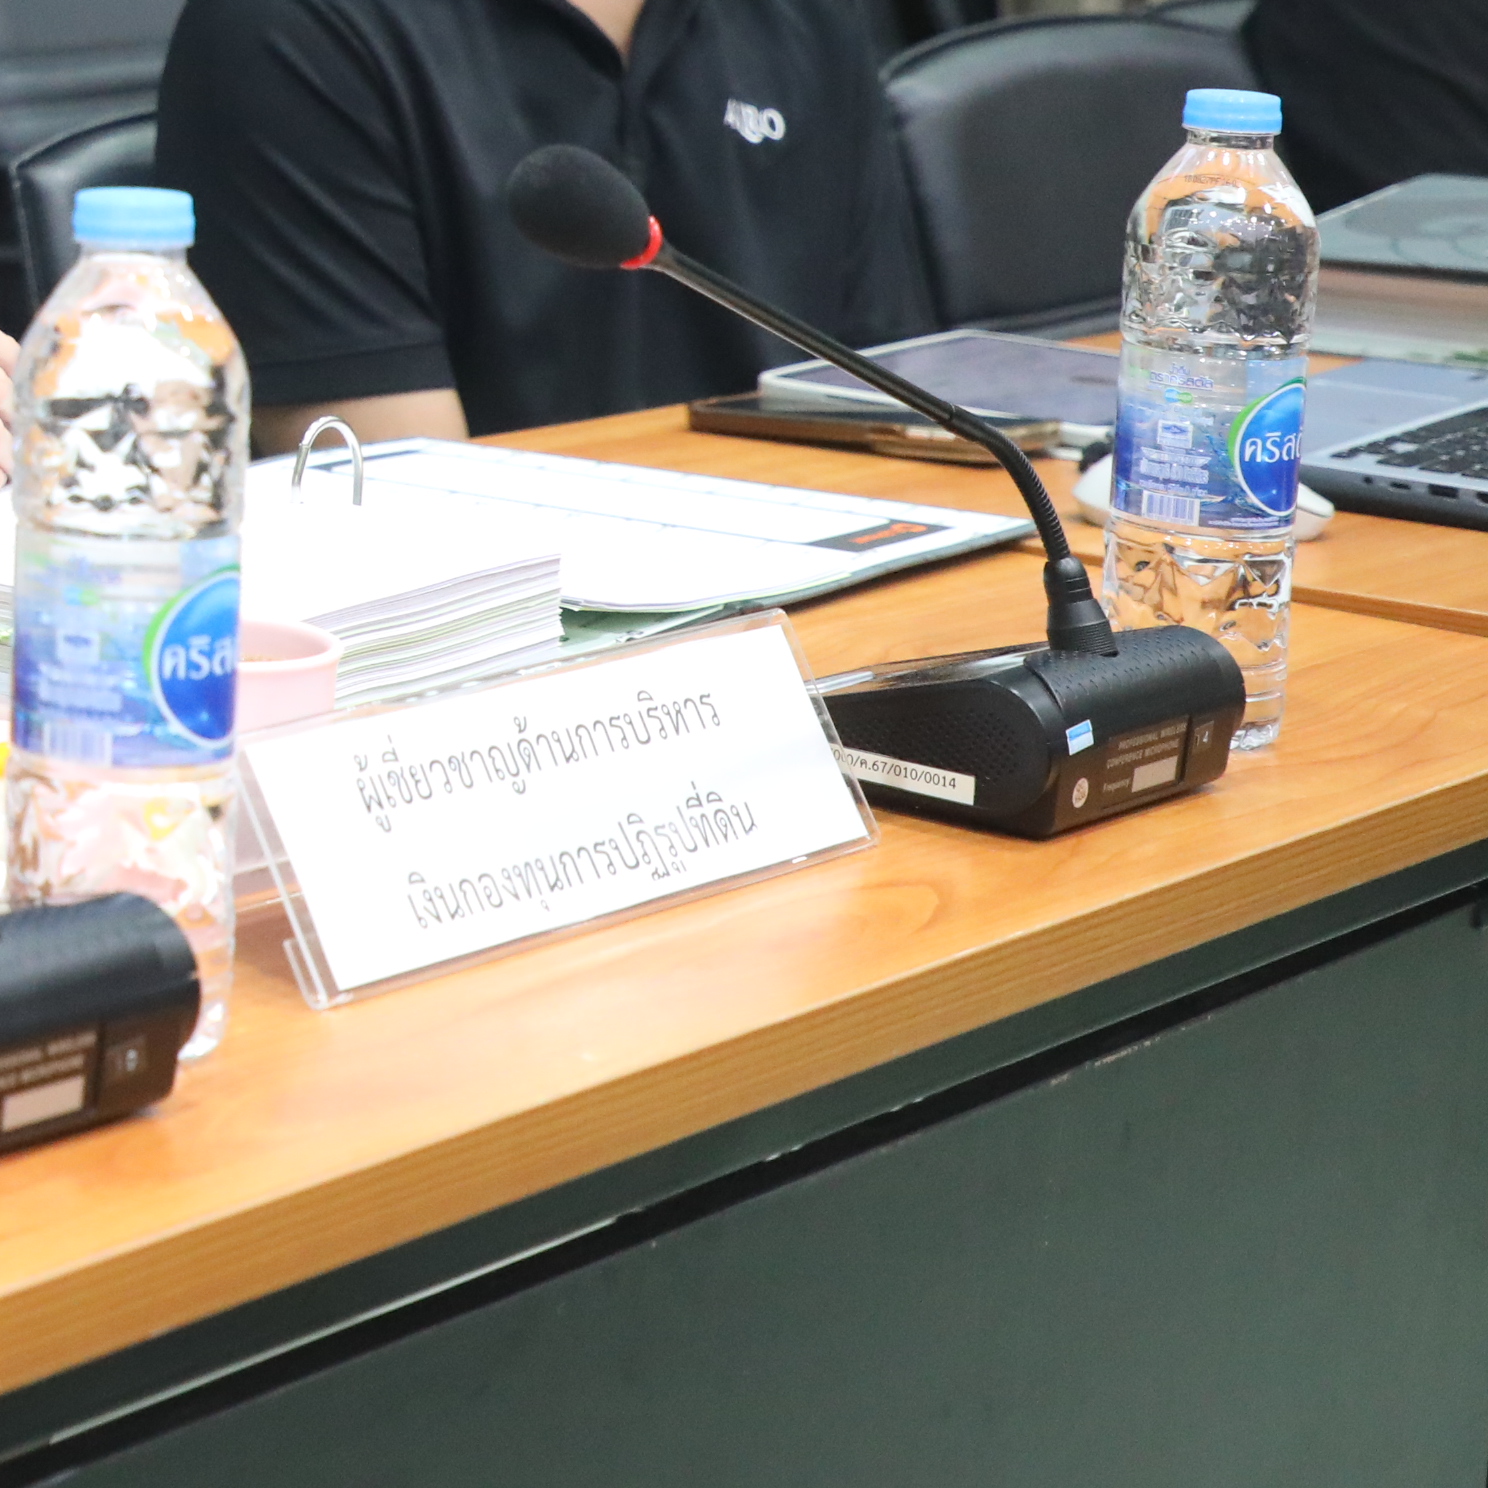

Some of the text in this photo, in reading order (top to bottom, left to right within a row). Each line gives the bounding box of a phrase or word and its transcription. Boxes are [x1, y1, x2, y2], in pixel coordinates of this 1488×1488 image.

[353, 690, 721, 832] ผู้เชี่ยวชาญด้านการบริหาร
[407, 781, 759, 928] เงินกองทุนการปฏิรูปที่ดิน
